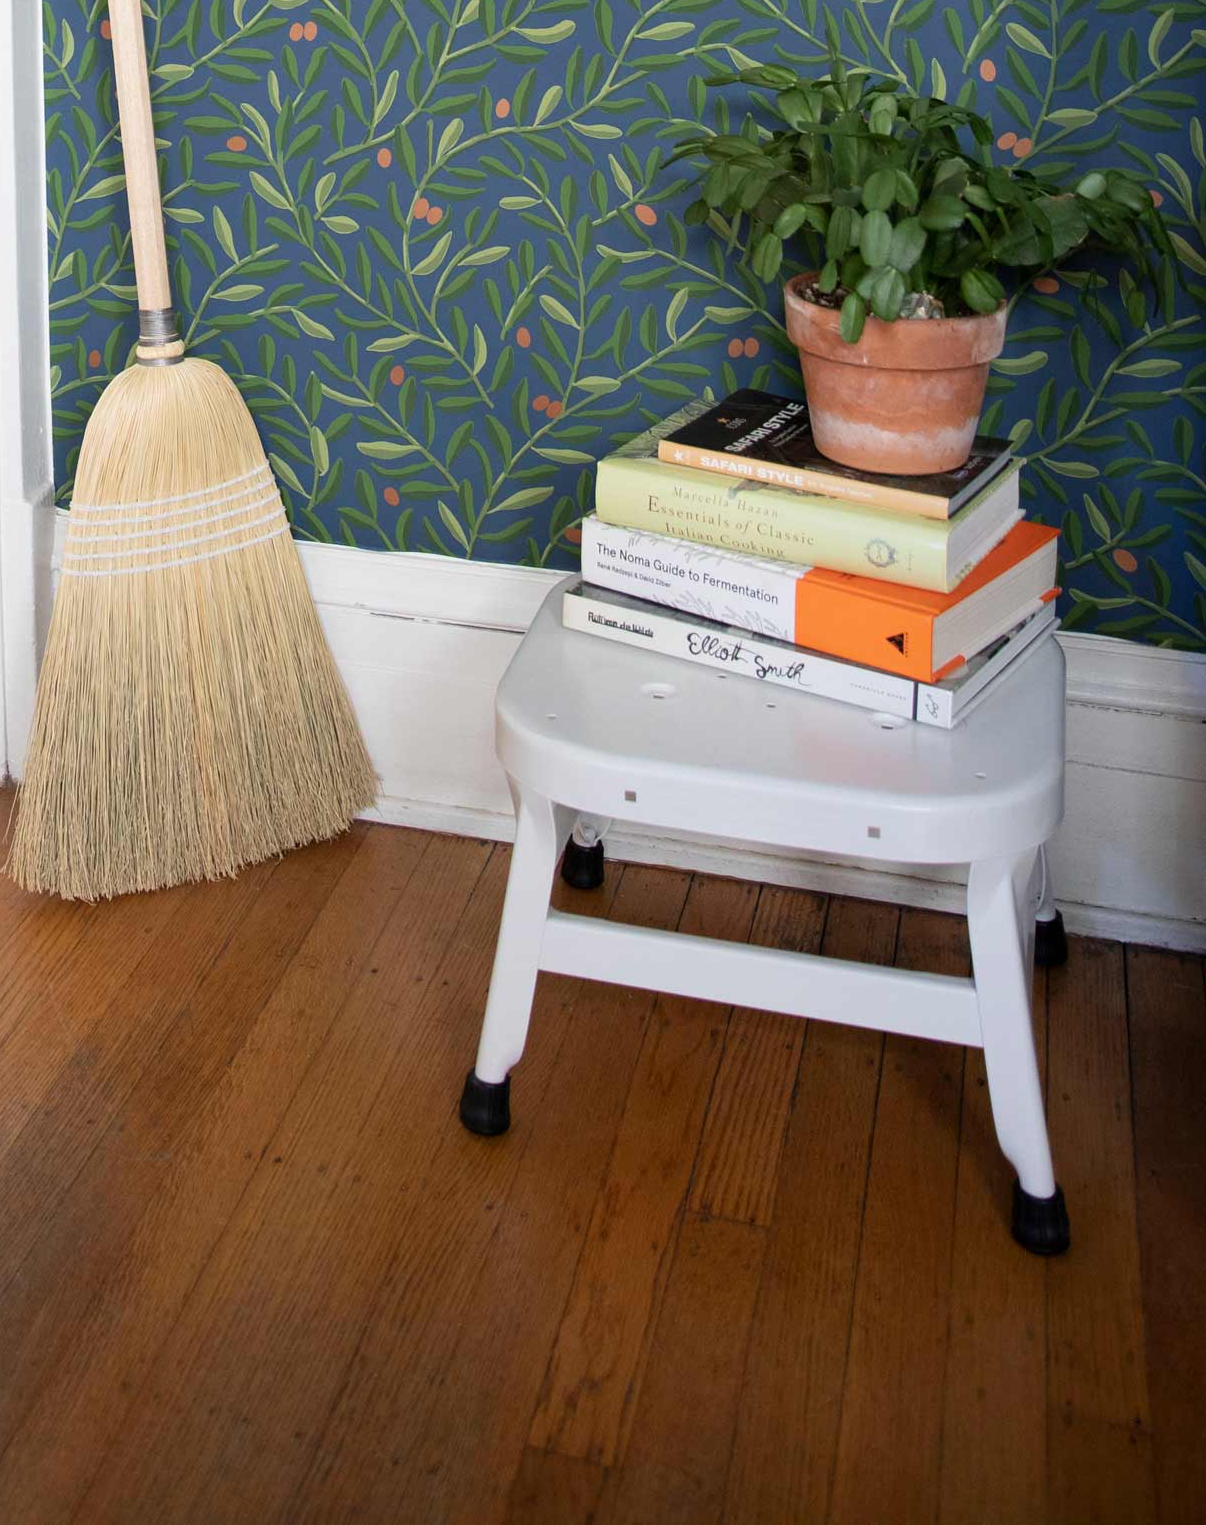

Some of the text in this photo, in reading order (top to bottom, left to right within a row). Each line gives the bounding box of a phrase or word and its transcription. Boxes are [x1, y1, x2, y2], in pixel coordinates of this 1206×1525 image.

[724, 427, 772, 452] SAFARI
[766, 402, 805, 430] STYLE
[700, 456, 753, 475] SAFARI
[757, 468, 803, 486] STYLE
[648, 494, 815, 546] Essentials of Classic
[673, 486, 778, 518] Marcella Hazan
[665, 522, 785, 557] Italian Cooking
[596, 542, 779, 605] The Noma Guide to Fermentation
[687, 632, 812, 686] Elliott Smith
